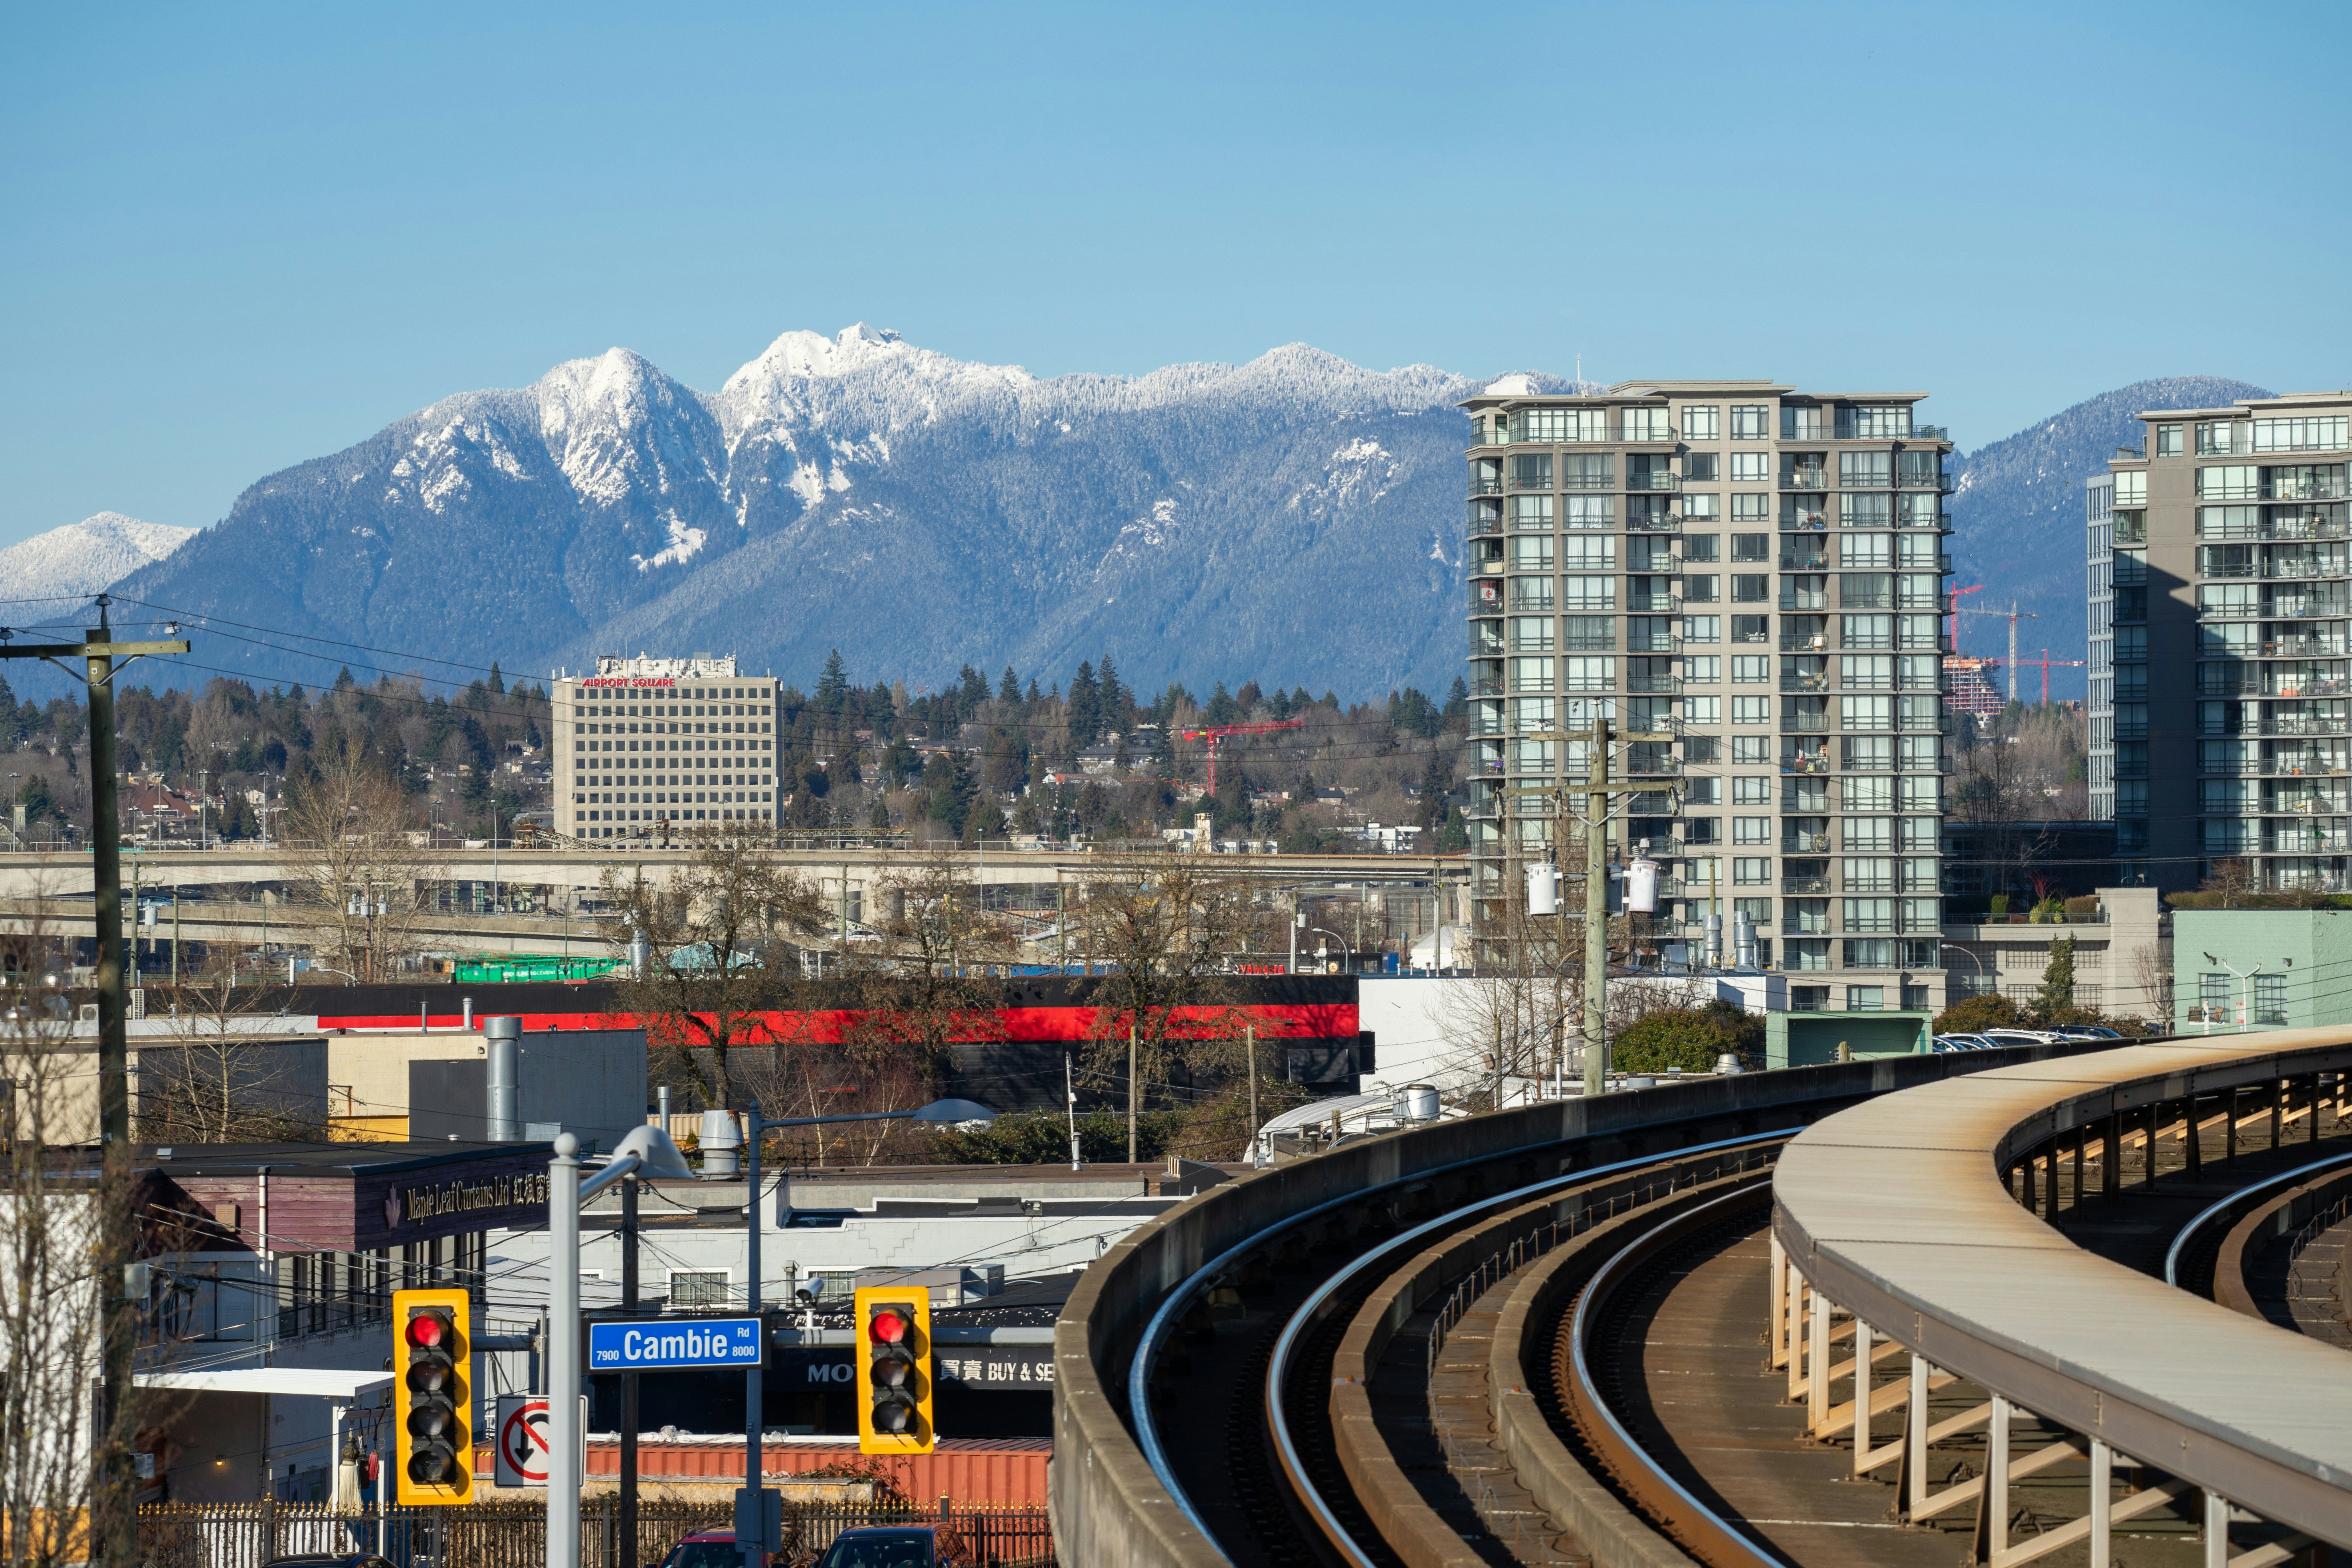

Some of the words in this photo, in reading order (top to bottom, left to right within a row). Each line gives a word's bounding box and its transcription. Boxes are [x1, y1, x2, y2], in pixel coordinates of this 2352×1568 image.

[581, 678, 629, 687] AIRPORT
[632, 678, 675, 687] SQUARE
[407, 1186, 434, 1225] Maple
[435, 1182, 455, 1215] Leaf
[456, 1180, 493, 1211] Curtains
[494, 1176, 509, 1206] Ltd
[624, 1328, 727, 1360] Cambie
[737, 1327, 749, 1337] Rd
[732, 1346, 755, 1356] 8000
[596, 1350, 619, 1361] 7900
[808, 1364, 857, 1382] MO
[940, 1360, 982, 1380] 買賣
[988, 1362, 1017, 1381] BUY
[1020, 1362, 1031, 1381] &
